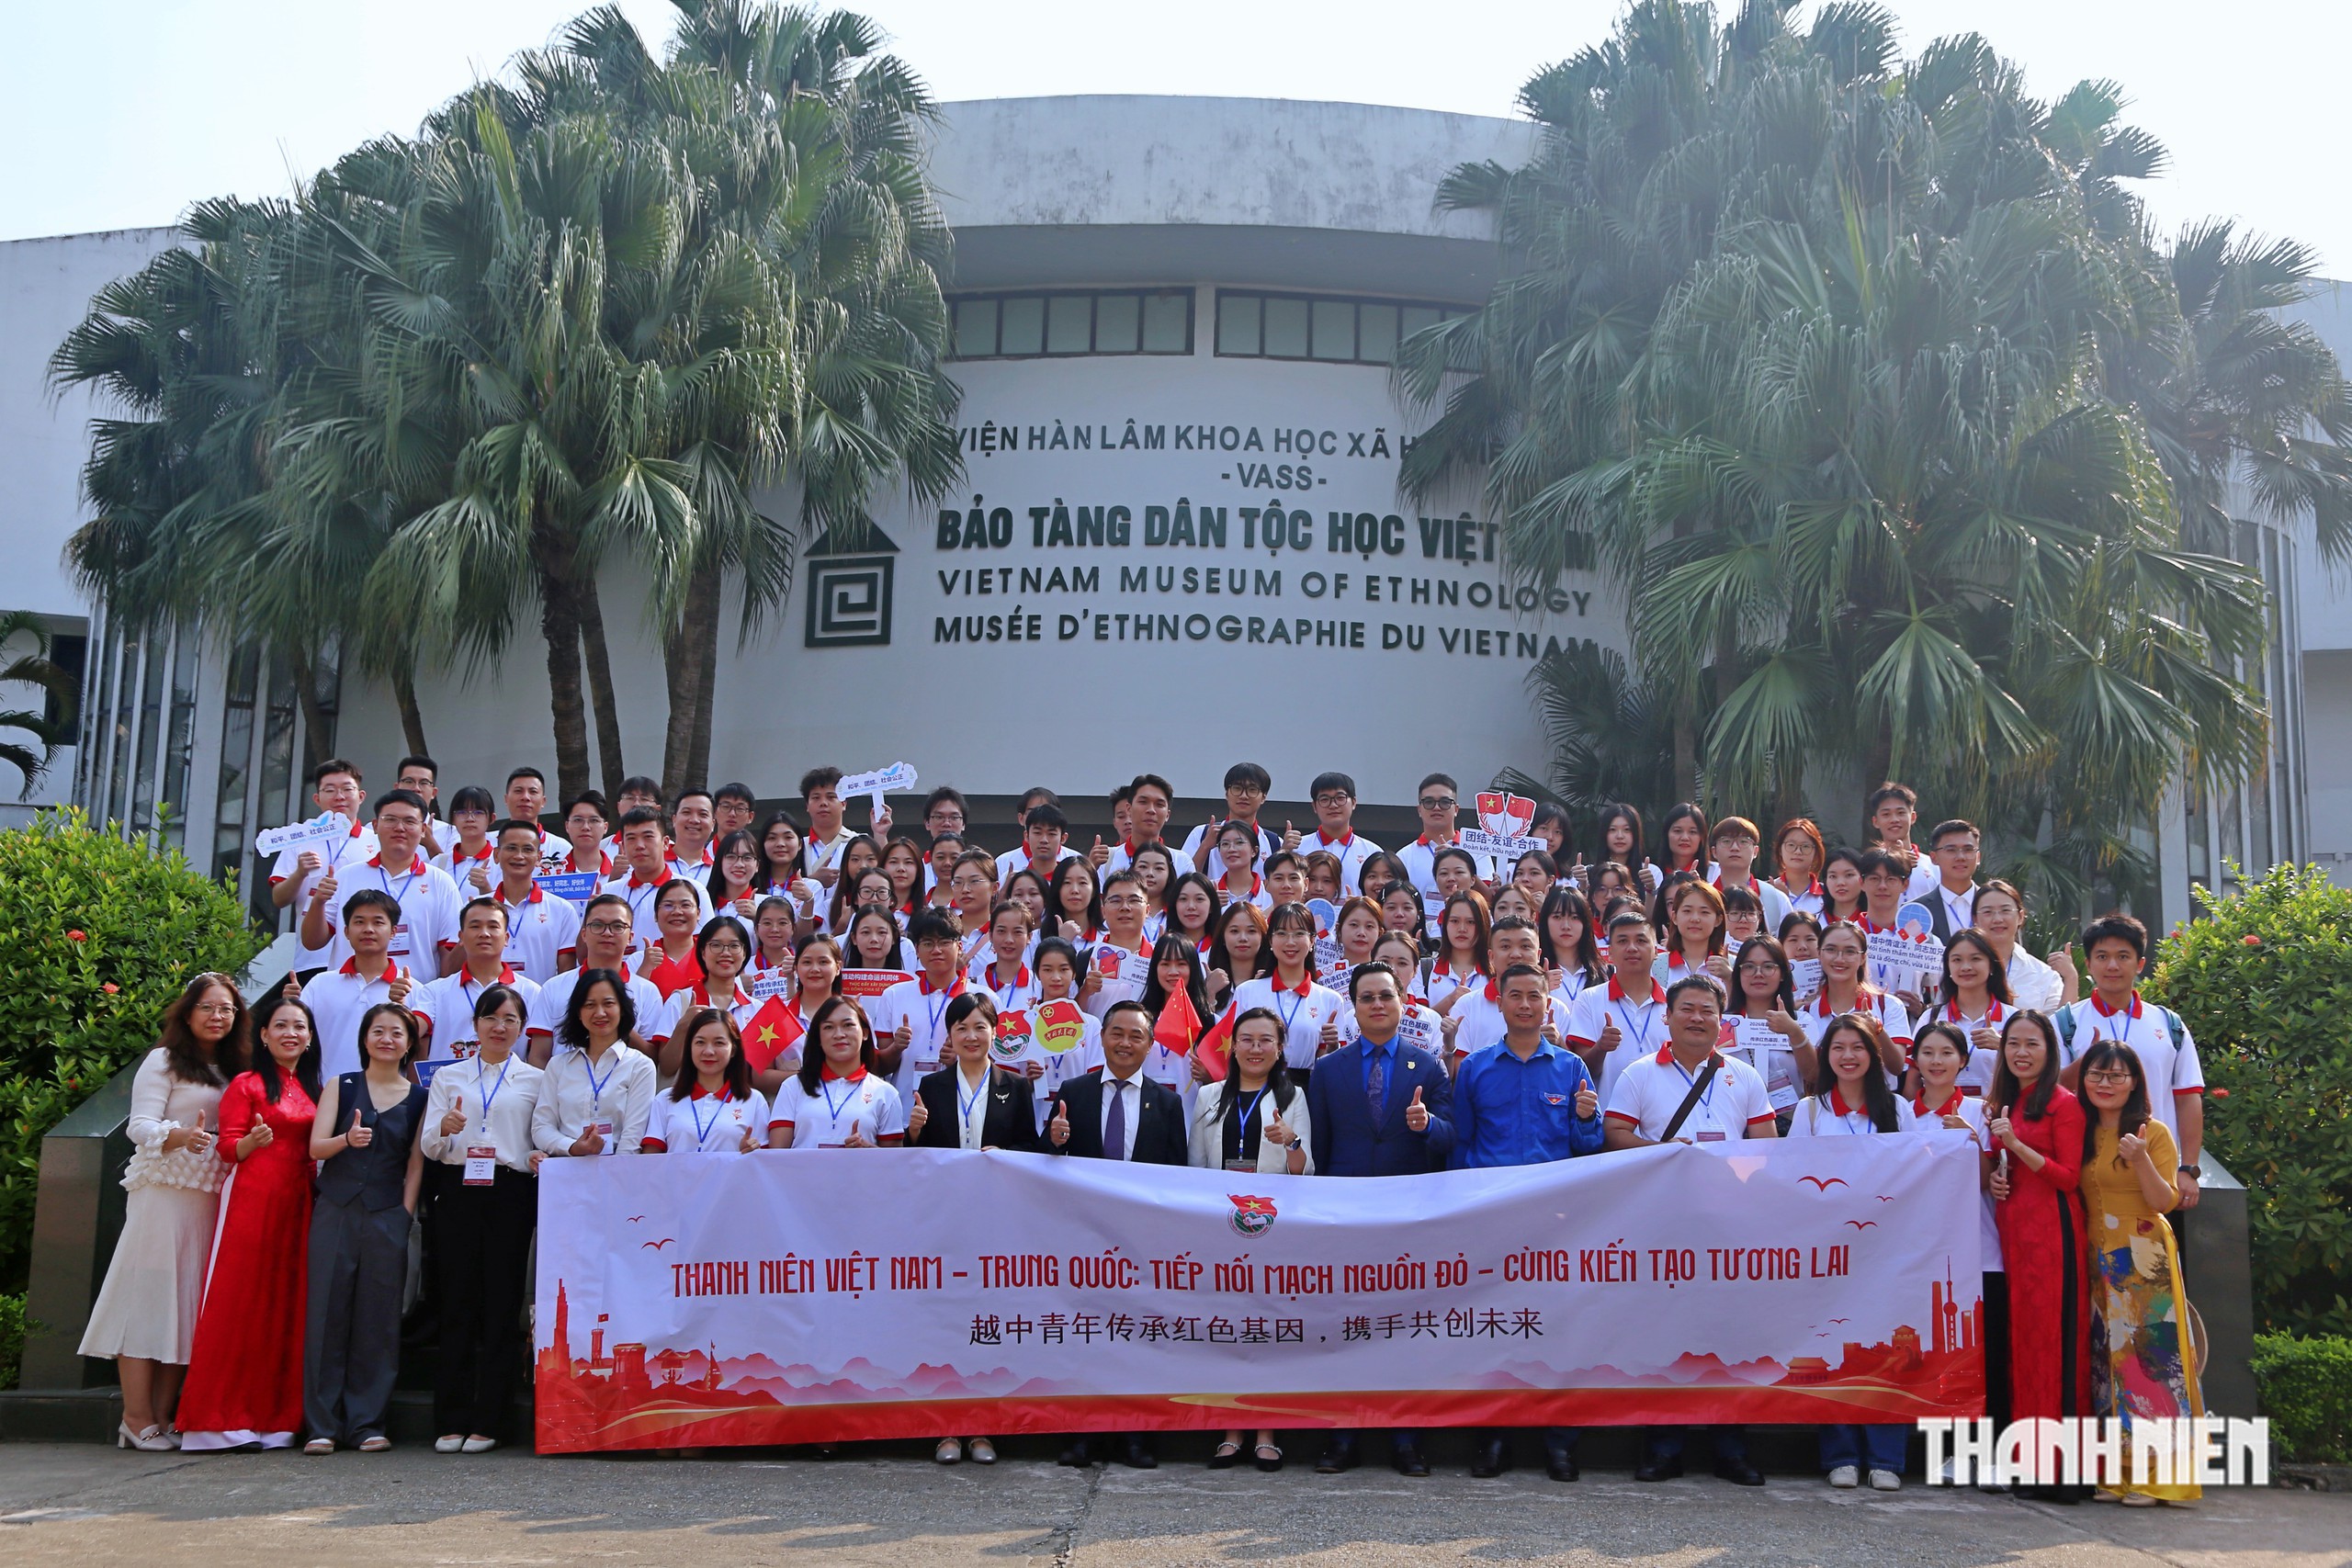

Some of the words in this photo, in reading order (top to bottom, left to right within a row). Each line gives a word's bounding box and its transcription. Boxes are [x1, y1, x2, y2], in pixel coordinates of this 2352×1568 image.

[1028, 417, 1091, 450] HÀN
[1101, 417, 1166, 450] LÂM
[1174, 424, 1264, 452] KHOA
[1274, 427, 1338, 460] HỌC
[1346, 427, 1391, 459] XÃ
[936, 493, 1013, 549] BẢO
[1028, 497, 1132, 547] TÀNG
[1144, 497, 1227, 547] DÂN
[1238, 499, 1313, 557] TỘC
[1328, 511, 1405, 561] HỌC
[1418, 512, 1499, 567] VIỆT
[938, 566, 1100, 595] VIETNAM
[1120, 566, 1282, 596] MUSEUM
[1300, 570, 1349, 599] OF
[1365, 575, 1591, 617] ETHNOLOGY
[934, 604, 1042, 642] MUSÉE
[1058, 608, 1365, 649] D'ETHNOGRAPHIE
[1382, 623, 1425, 651] DU
[1463, 843, 1478, 852] Đoàn
[1479, 844, 1491, 853] kết,
[671, 1261, 749, 1297] THANH
[759, 1252, 814, 1294] NIÊN
[825, 1250, 879, 1299] VIỆT
[890, 1257, 943, 1290] NAM
[978, 1254, 1059, 1289] TRUNG
[1069, 1247, 1140, 1290] QUỐC:
[1149, 1252, 1204, 1291] TIẾP
[1215, 1254, 1254, 1293] NỐI
[1264, 1265, 1333, 1302] MẠCH
[1343, 1253, 1426, 1293] NGUỒN
[1434, 1252, 1468, 1289] ĐỎ
[1504, 1247, 1569, 1282] CÙNG
[1579, 1239, 1636, 1282] KIẾN
[1647, 1248, 1695, 1289] TẠO
[1707, 1247, 1801, 1282] TƯƠNG
[1811, 1244, 1850, 1278] LAI
